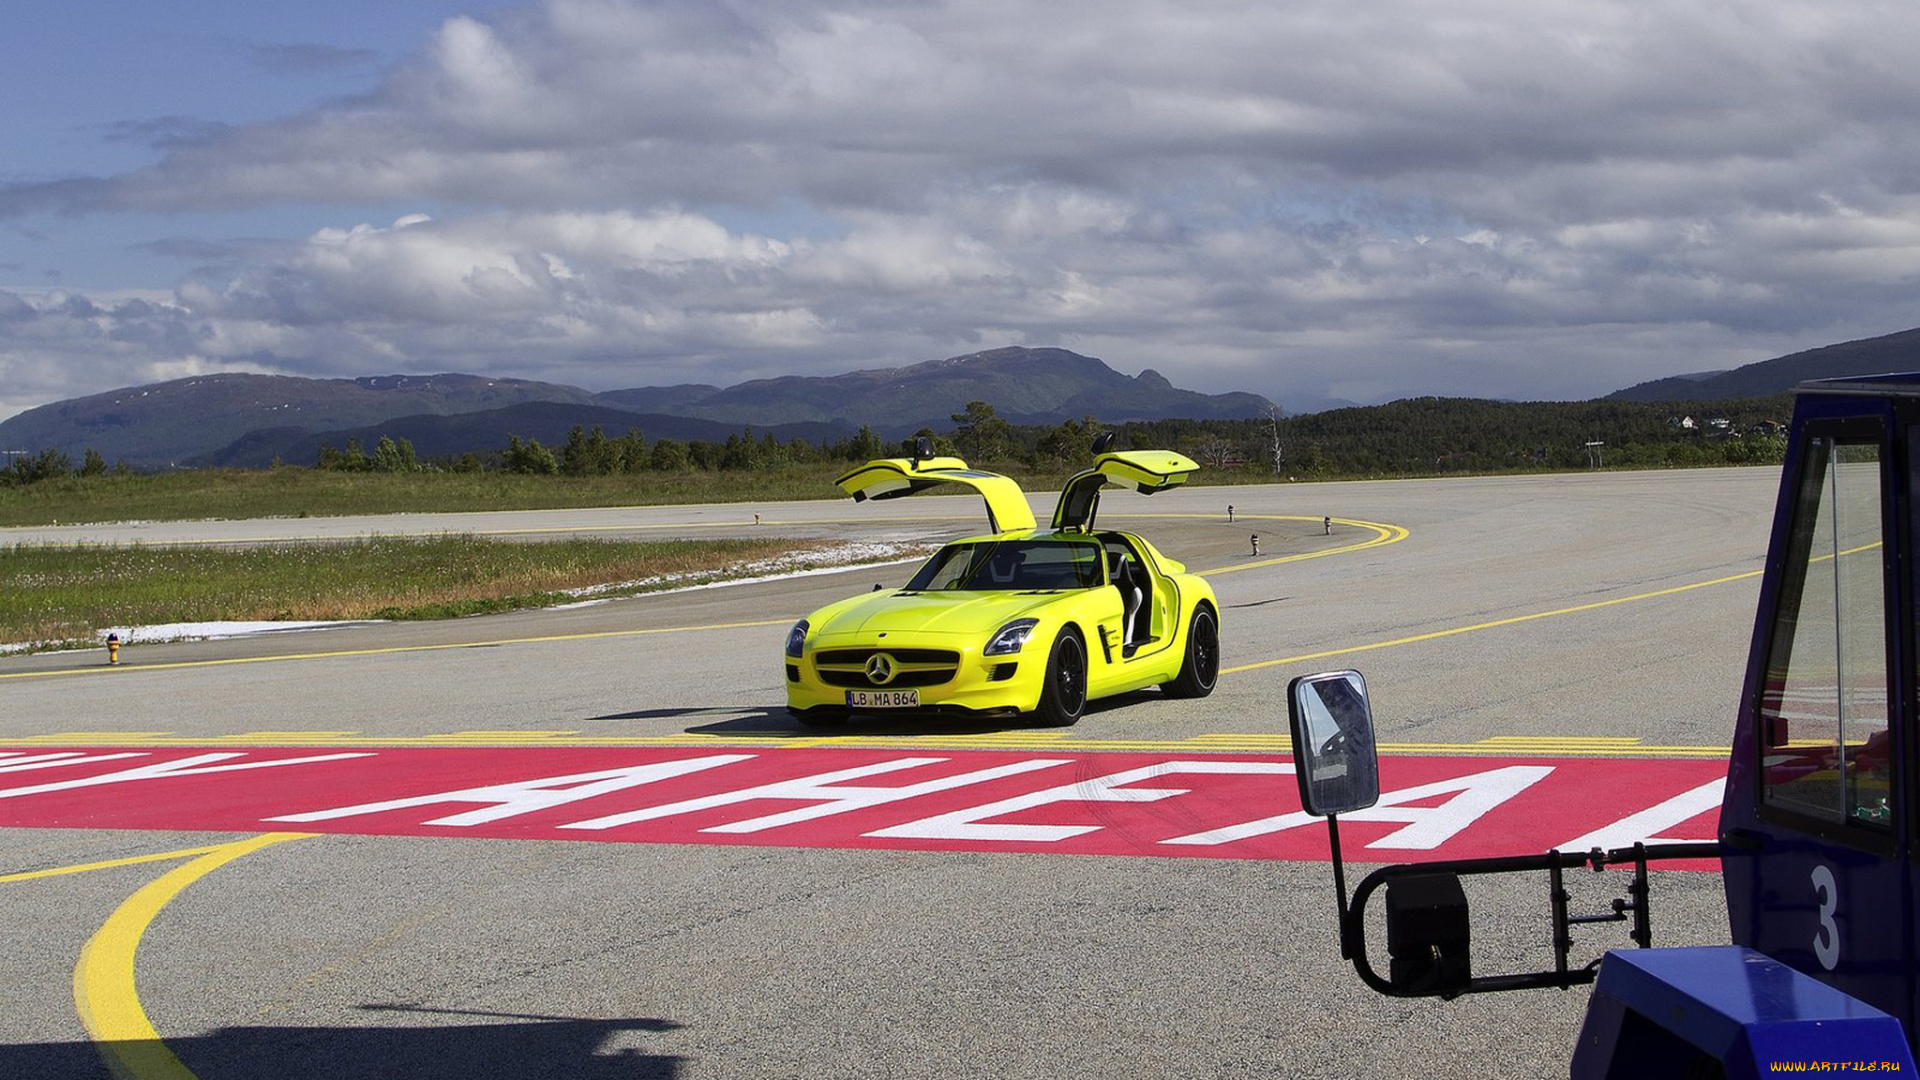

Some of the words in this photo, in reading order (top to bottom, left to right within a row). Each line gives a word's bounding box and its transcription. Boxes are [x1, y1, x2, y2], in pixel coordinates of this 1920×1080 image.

[851, 692, 868, 706] LB
[874, 692, 891, 706] MA
[893, 692, 917, 706] 864
[1810, 864, 1840, 971] 3
